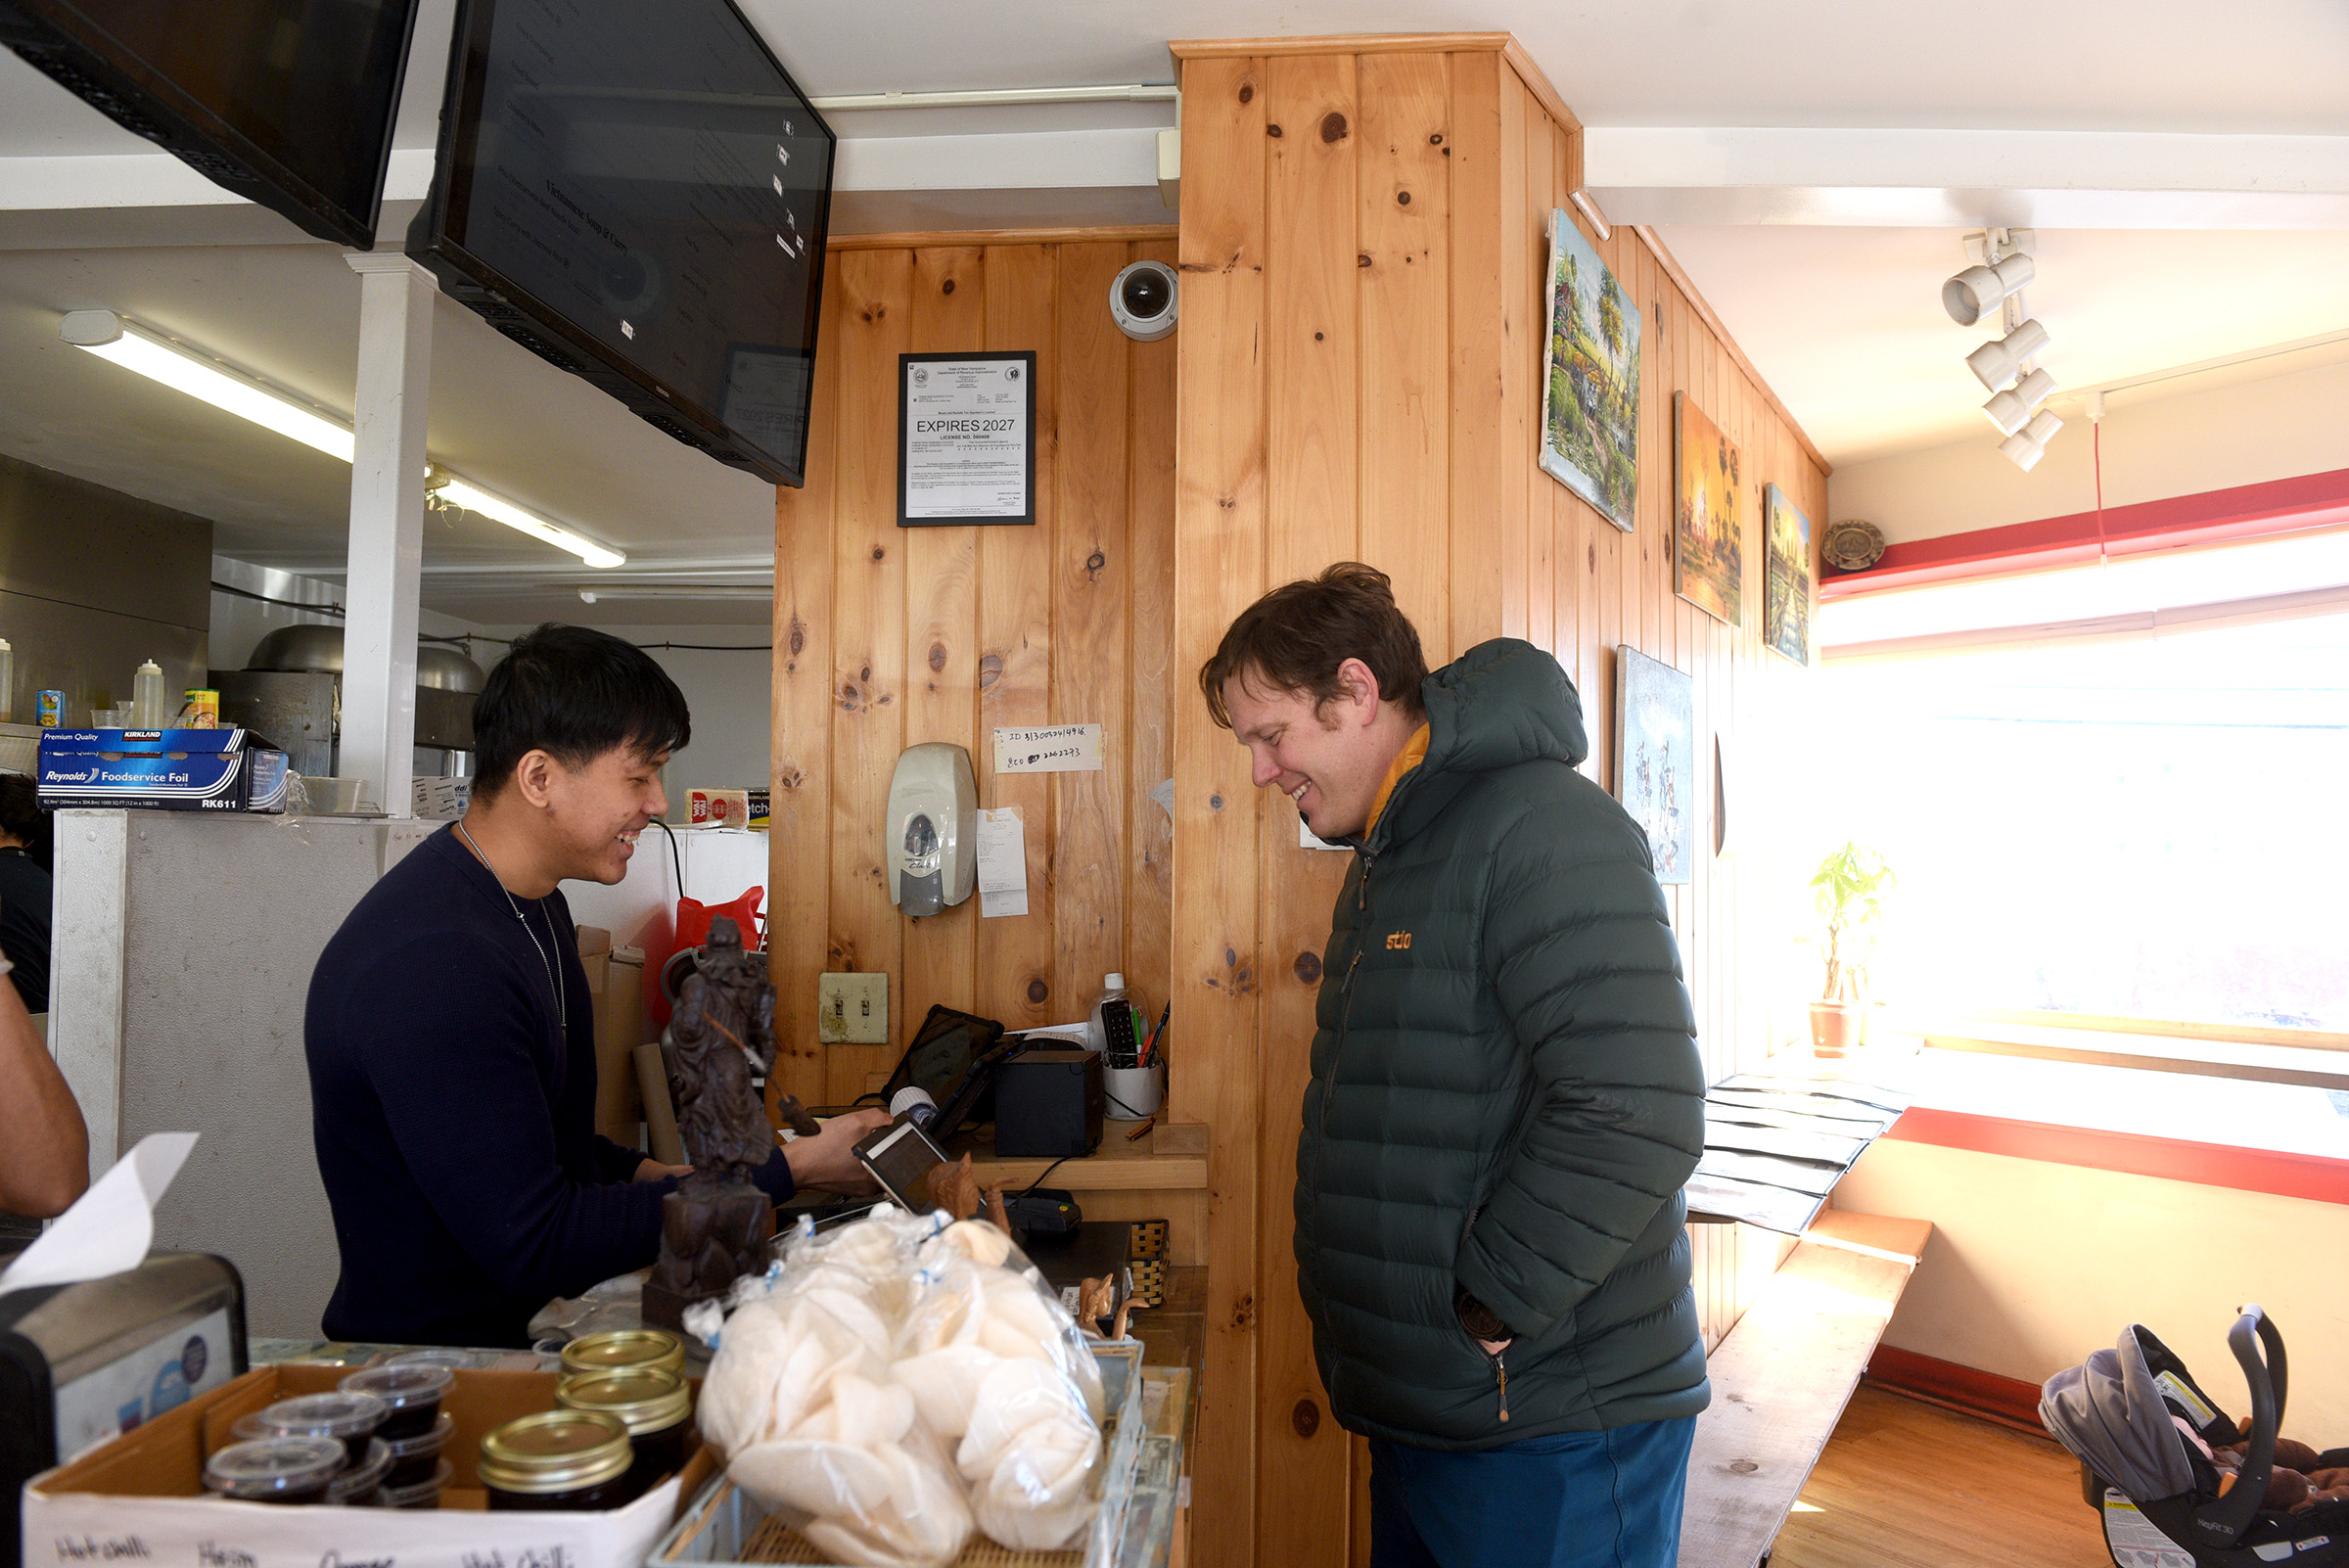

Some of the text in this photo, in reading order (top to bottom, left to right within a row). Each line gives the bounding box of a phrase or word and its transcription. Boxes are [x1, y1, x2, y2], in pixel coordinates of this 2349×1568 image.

[546, 179, 585, 219] Vietnamese
[585, 212, 603, 235] Soup
[610, 233, 627, 255] Curry
[917, 419, 1015, 433] EXPIRES 2027
[74, 733, 99, 742] Quality
[45, 770, 88, 782] Reynolds
[102, 771, 189, 783] Foodservice Foil
[202, 799, 236, 808] RK611
[1386, 929, 1412, 950] stio
